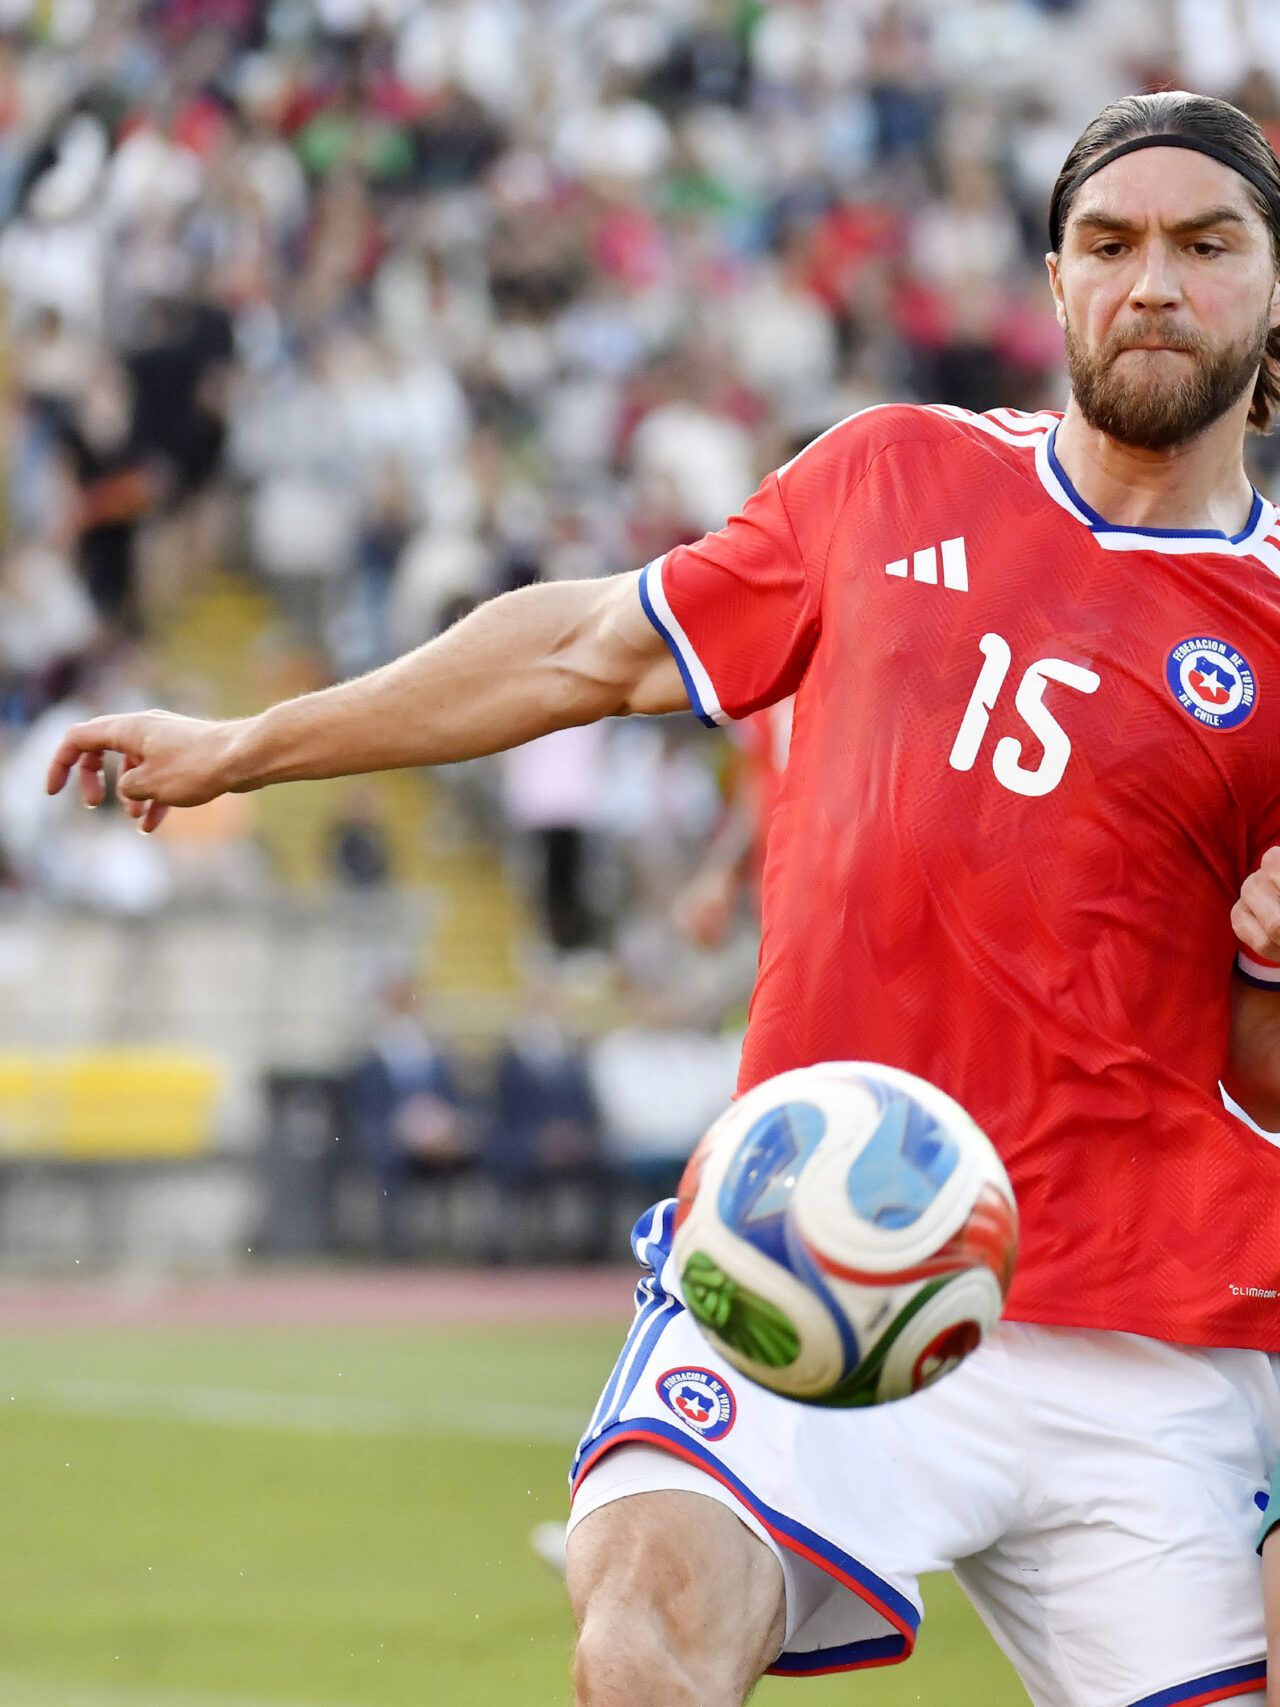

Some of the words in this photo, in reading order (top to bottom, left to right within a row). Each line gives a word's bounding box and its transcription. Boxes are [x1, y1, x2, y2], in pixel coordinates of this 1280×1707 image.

[1172, 639, 1227, 662] FEDERACION
[1229, 653, 1244, 667] DE
[1240, 670, 1254, 707] FUTBOL
[949, 633, 1100, 797] 15
[1178, 694, 1192, 708] DE
[1194, 708, 1220, 726] CHILE
[709, 1381, 722, 1392] DE
